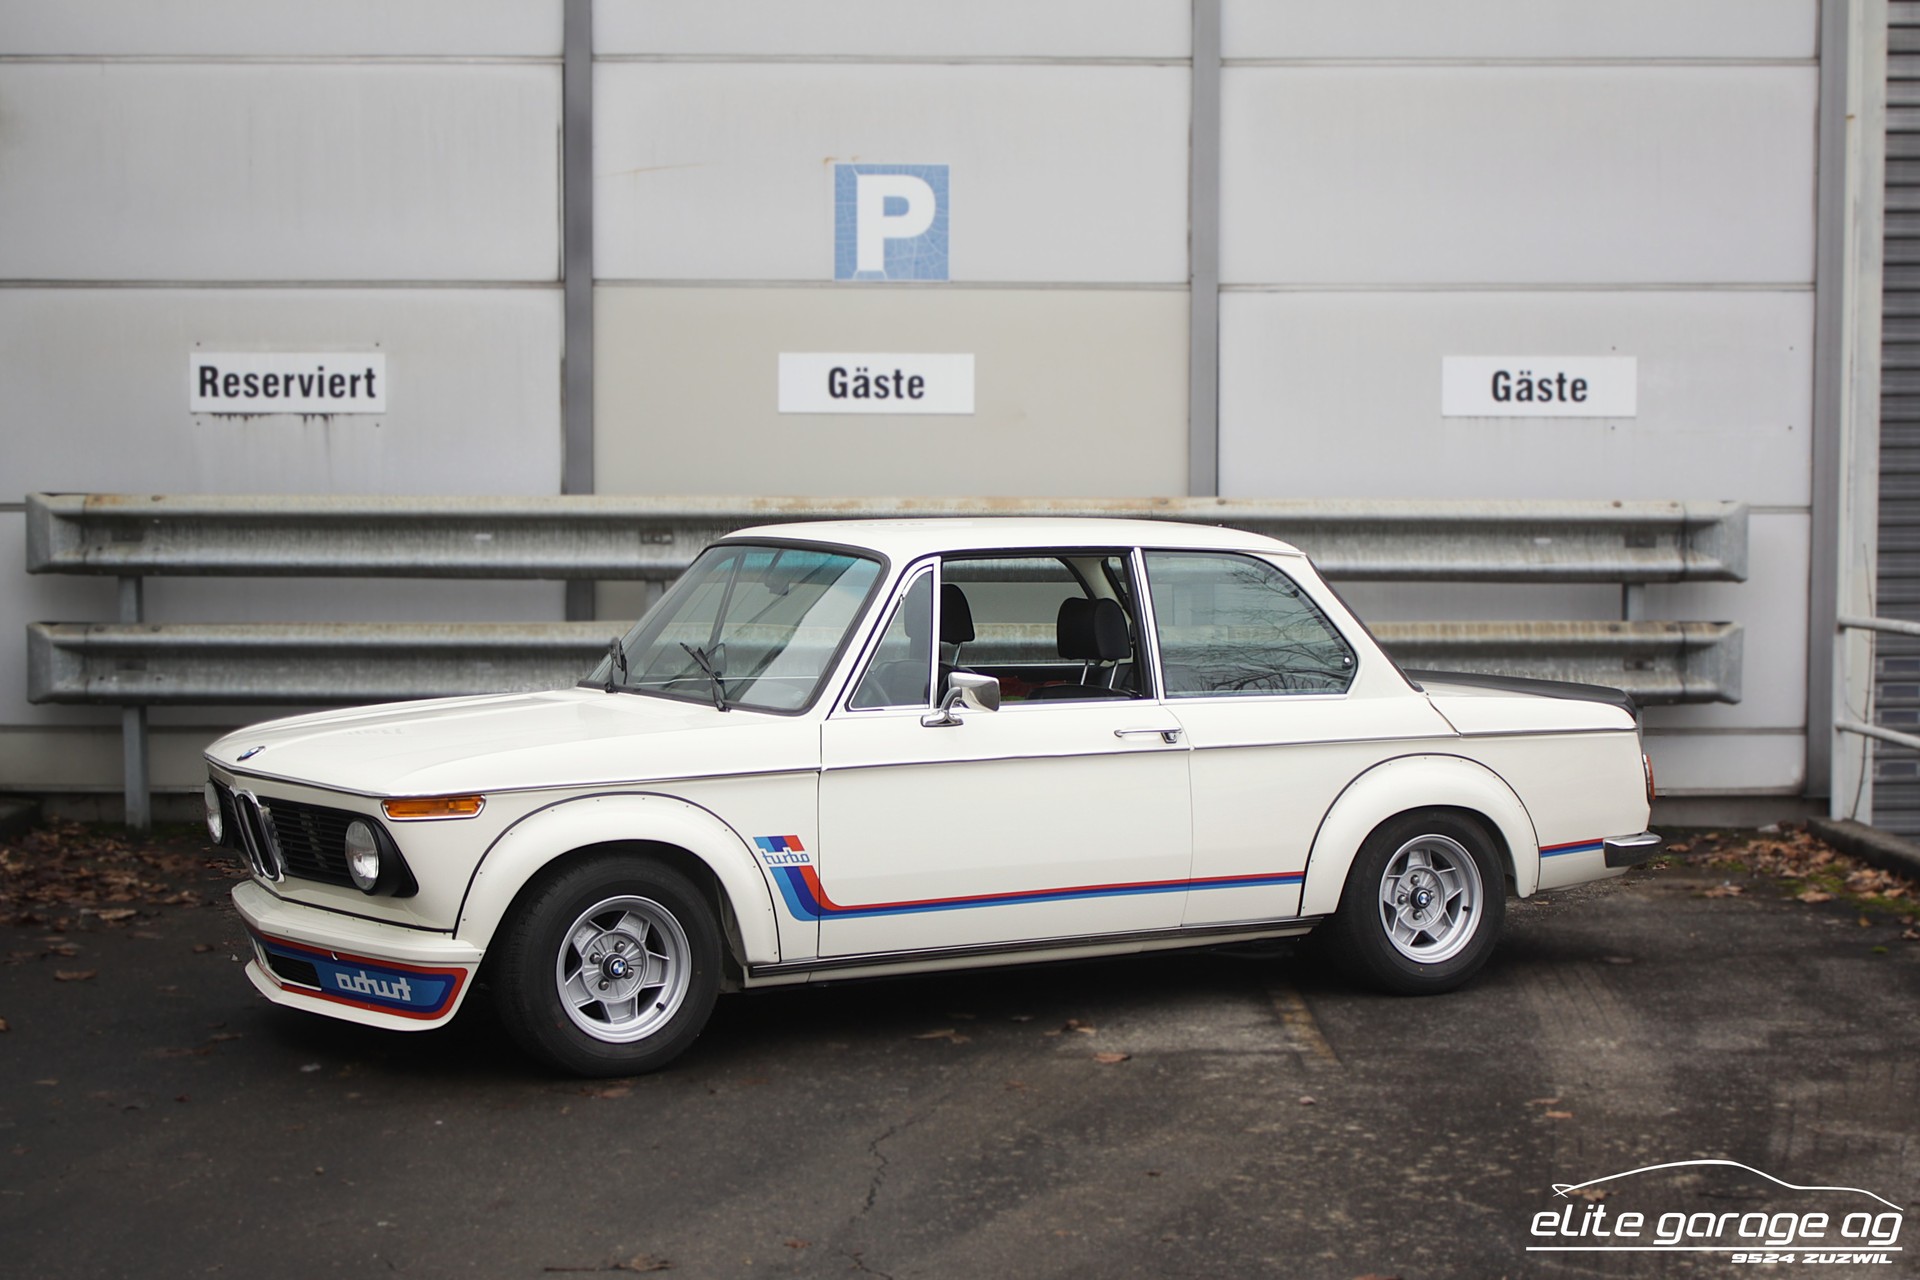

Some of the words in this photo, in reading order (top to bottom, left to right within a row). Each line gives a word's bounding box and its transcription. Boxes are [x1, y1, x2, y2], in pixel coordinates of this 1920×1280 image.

[857, 174, 935, 271] P
[199, 365, 376, 399] Reserviert
[828, 367, 925, 399] Gäste
[1491, 370, 1588, 403] Gäste
[761, 849, 811, 865] turbo
